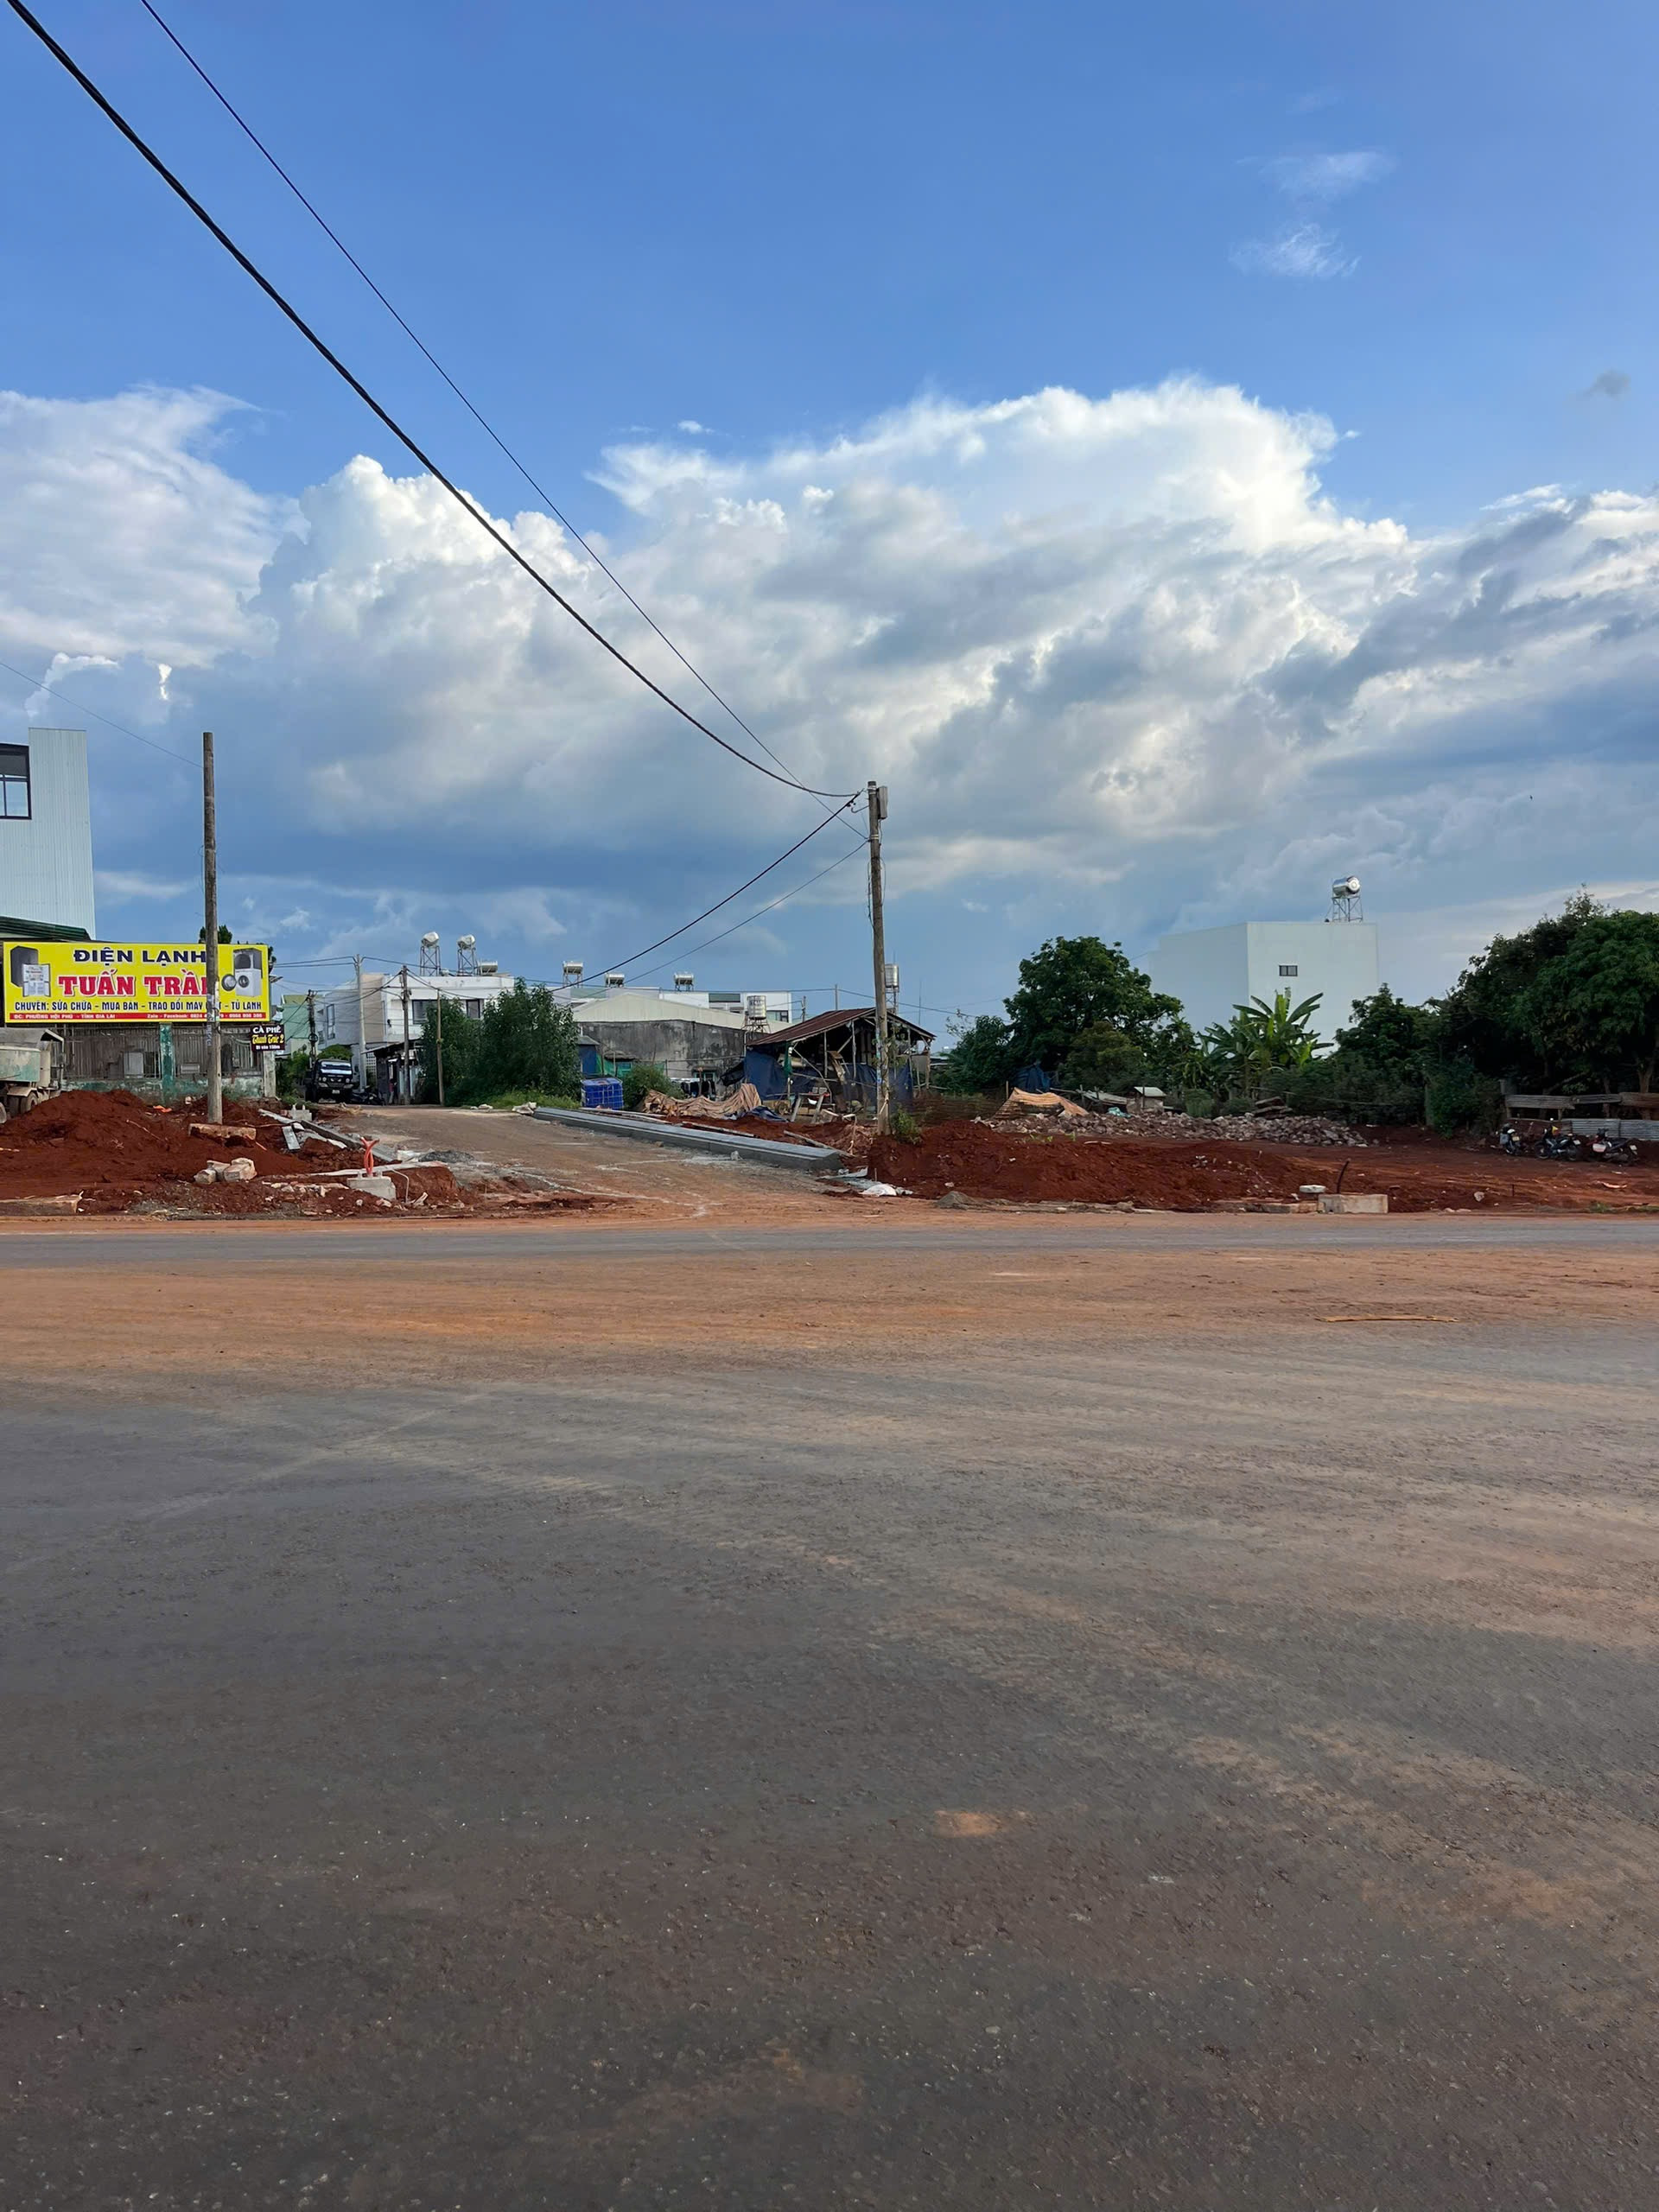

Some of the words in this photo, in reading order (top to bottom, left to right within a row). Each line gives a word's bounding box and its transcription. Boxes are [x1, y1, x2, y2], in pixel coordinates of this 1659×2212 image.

[73, 947, 133, 966] ĐIỆN
[143, 950, 207, 966] LẠNH
[59, 969, 136, 995] TUẤN
[102, 1001, 121, 1011] MUA
[148, 1001, 168, 1011] TRAO
[252, 1025, 264, 1033] CÀ
[266, 1025, 282, 1033] PHÊ
[279, 1033, 284, 1044] 2
